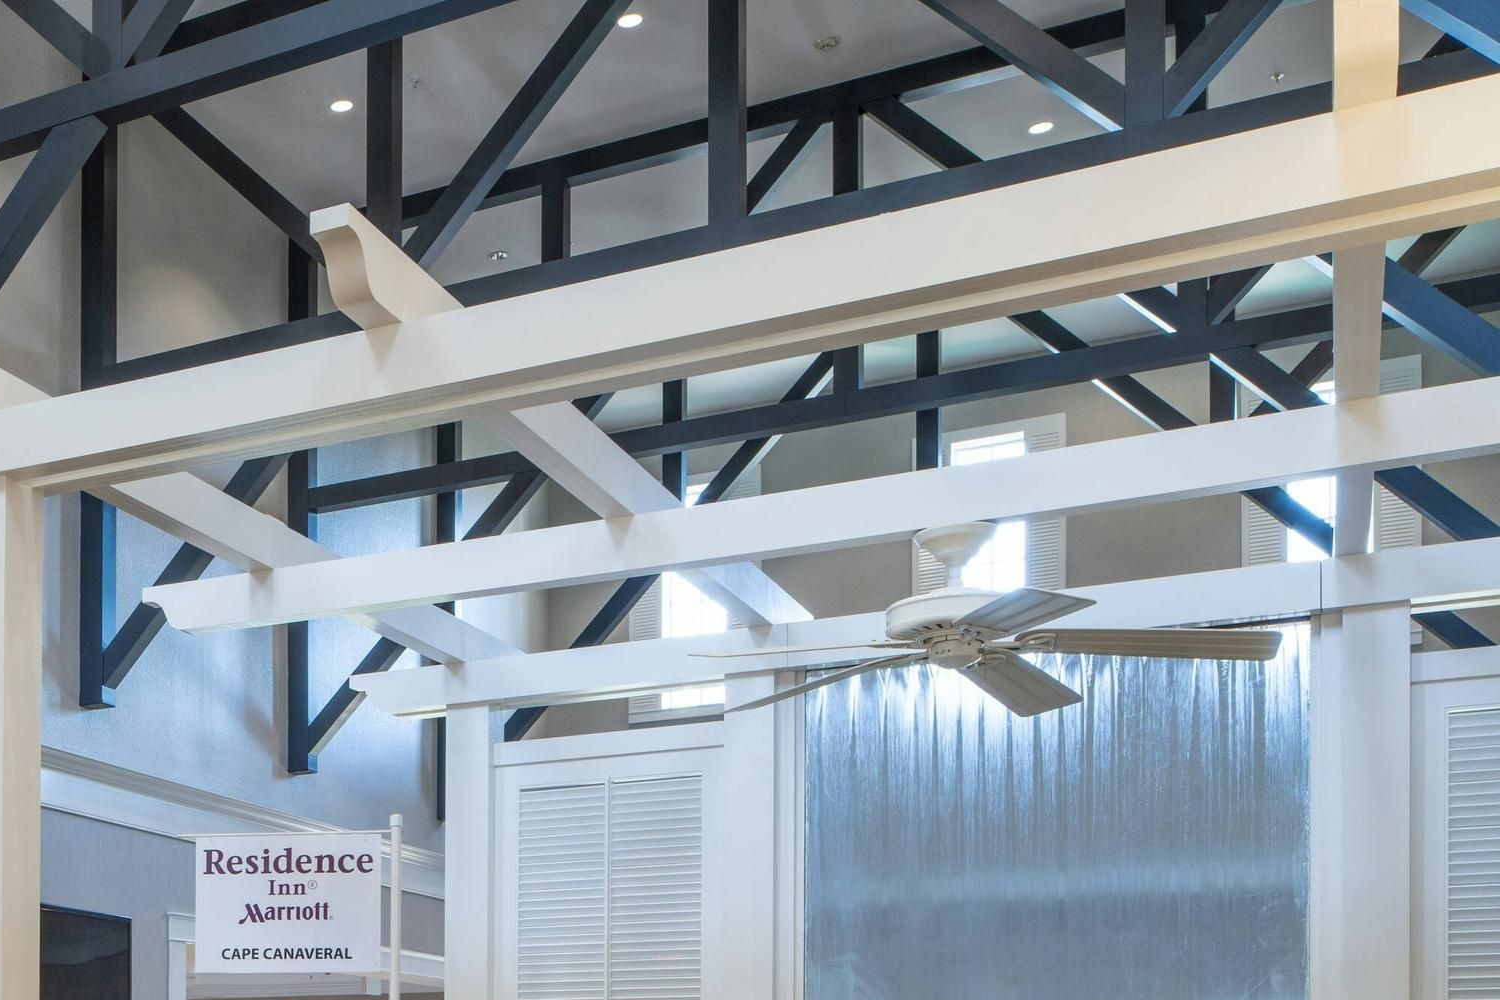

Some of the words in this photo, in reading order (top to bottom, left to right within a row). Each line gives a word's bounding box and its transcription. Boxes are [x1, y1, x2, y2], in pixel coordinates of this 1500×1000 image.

[203, 847, 374, 875] Residence
[238, 902, 329, 925] Marriott
[221, 948, 259, 960] CAPE
[263, 947, 353, 960] CANAVERAL
